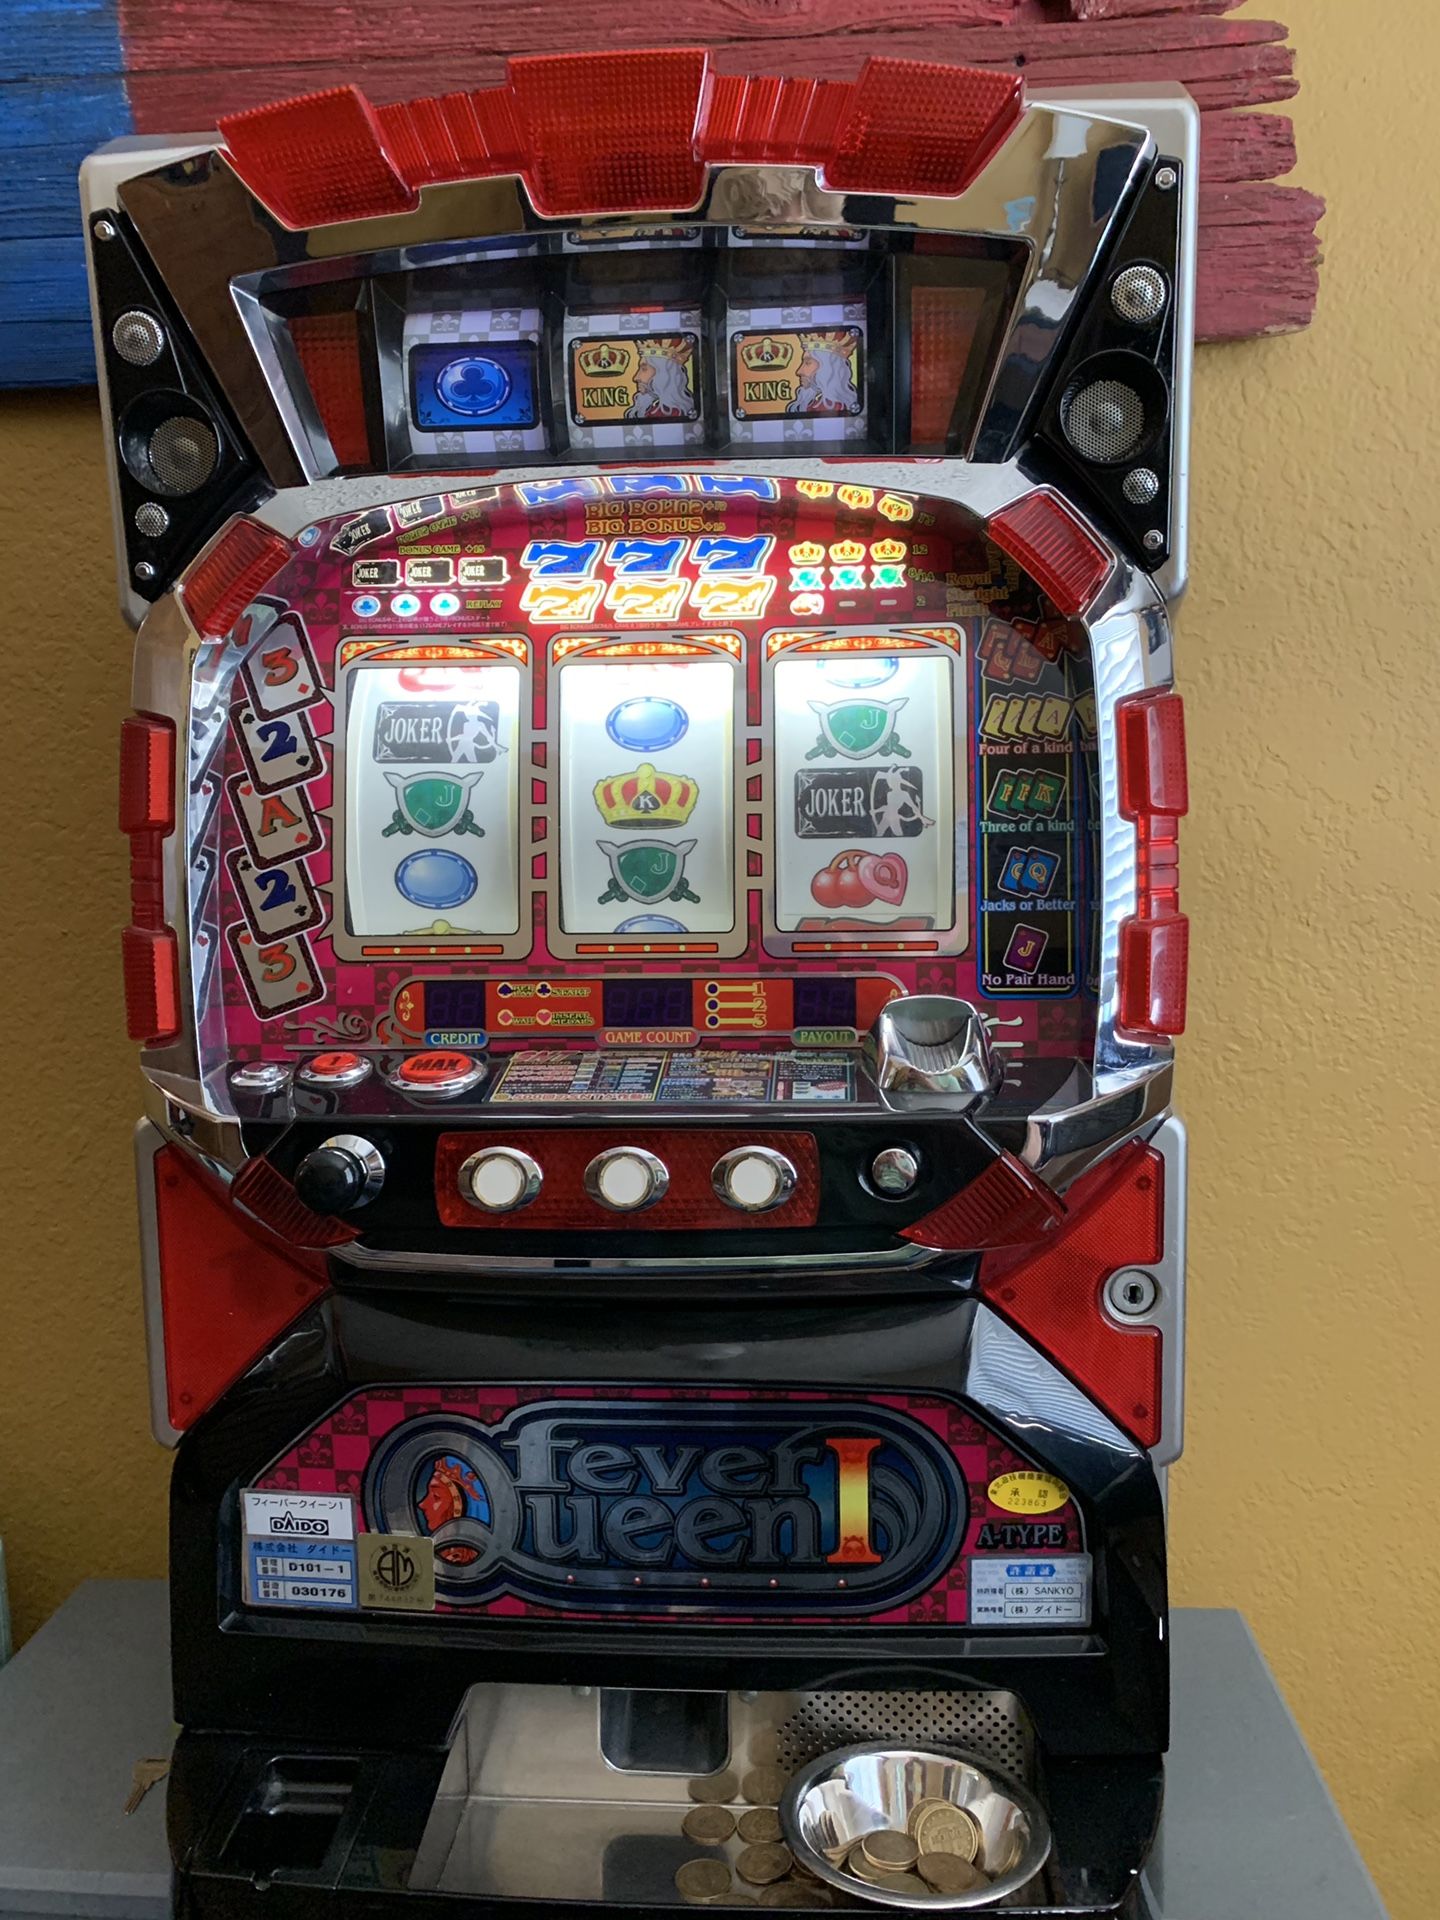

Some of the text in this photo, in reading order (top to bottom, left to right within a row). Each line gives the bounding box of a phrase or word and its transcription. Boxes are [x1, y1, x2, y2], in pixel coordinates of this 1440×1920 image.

[581, 386, 629, 408] KING
[744, 380, 791, 403] KING
[586, 519, 624, 535] BIG
[630, 517, 704, 535] BONUS
[398, 544, 431, 555] BONUS
[432, 544, 461, 554] GAME
[356, 564, 485, 580] JOKER JOKER JOKER
[946, 572, 992, 586] Royal
[261, 646, 299, 688] 3
[860, 710, 880, 729] J
[384, 716, 444, 745] JOKER
[256, 722, 297, 763] 2
[979, 743, 1008, 755] Four
[1013, 742, 1028, 754] of
[1030, 745, 1041, 754] a
[1044, 741, 1073, 753] kind
[438, 785, 455, 807] J
[638, 794, 653, 809] K
[805, 786, 868, 817] JOKER
[258, 796, 303, 837] A
[979, 820, 1074, 833] Three of a kind
[650, 852, 670, 872] J
[873, 863, 899, 889] Q
[1029, 863, 1048, 884] Q
[254, 868, 296, 911] 2
[980, 899, 1076, 912] Jacks or Better
[1017, 940, 1035, 957] J
[258, 943, 297, 983] 3
[981, 973, 1002, 986] No
[1006, 973, 1034, 985] Pair
[1037, 972, 1076, 985] Hand
[752, 981, 765, 996] 1
[752, 998, 767, 1012] 2
[752, 1014, 767, 1028] 3
[430, 1032, 481, 1046] CREDIT
[605, 1030, 692, 1043] GAME COUNT
[801, 1030, 851, 1042] PAYOUT
[411, 1057, 460, 1071] MAX
[502, 1421, 827, 1495] fever
[270, 1511, 328, 1535] DAIDO
[977, 1524, 1064, 1547] A-TYPE
[307, 1543, 351, 1556] ダイドー
[291, 1586, 346, 1598] 030176
[1034, 1585, 1075, 1596] SANKYO
